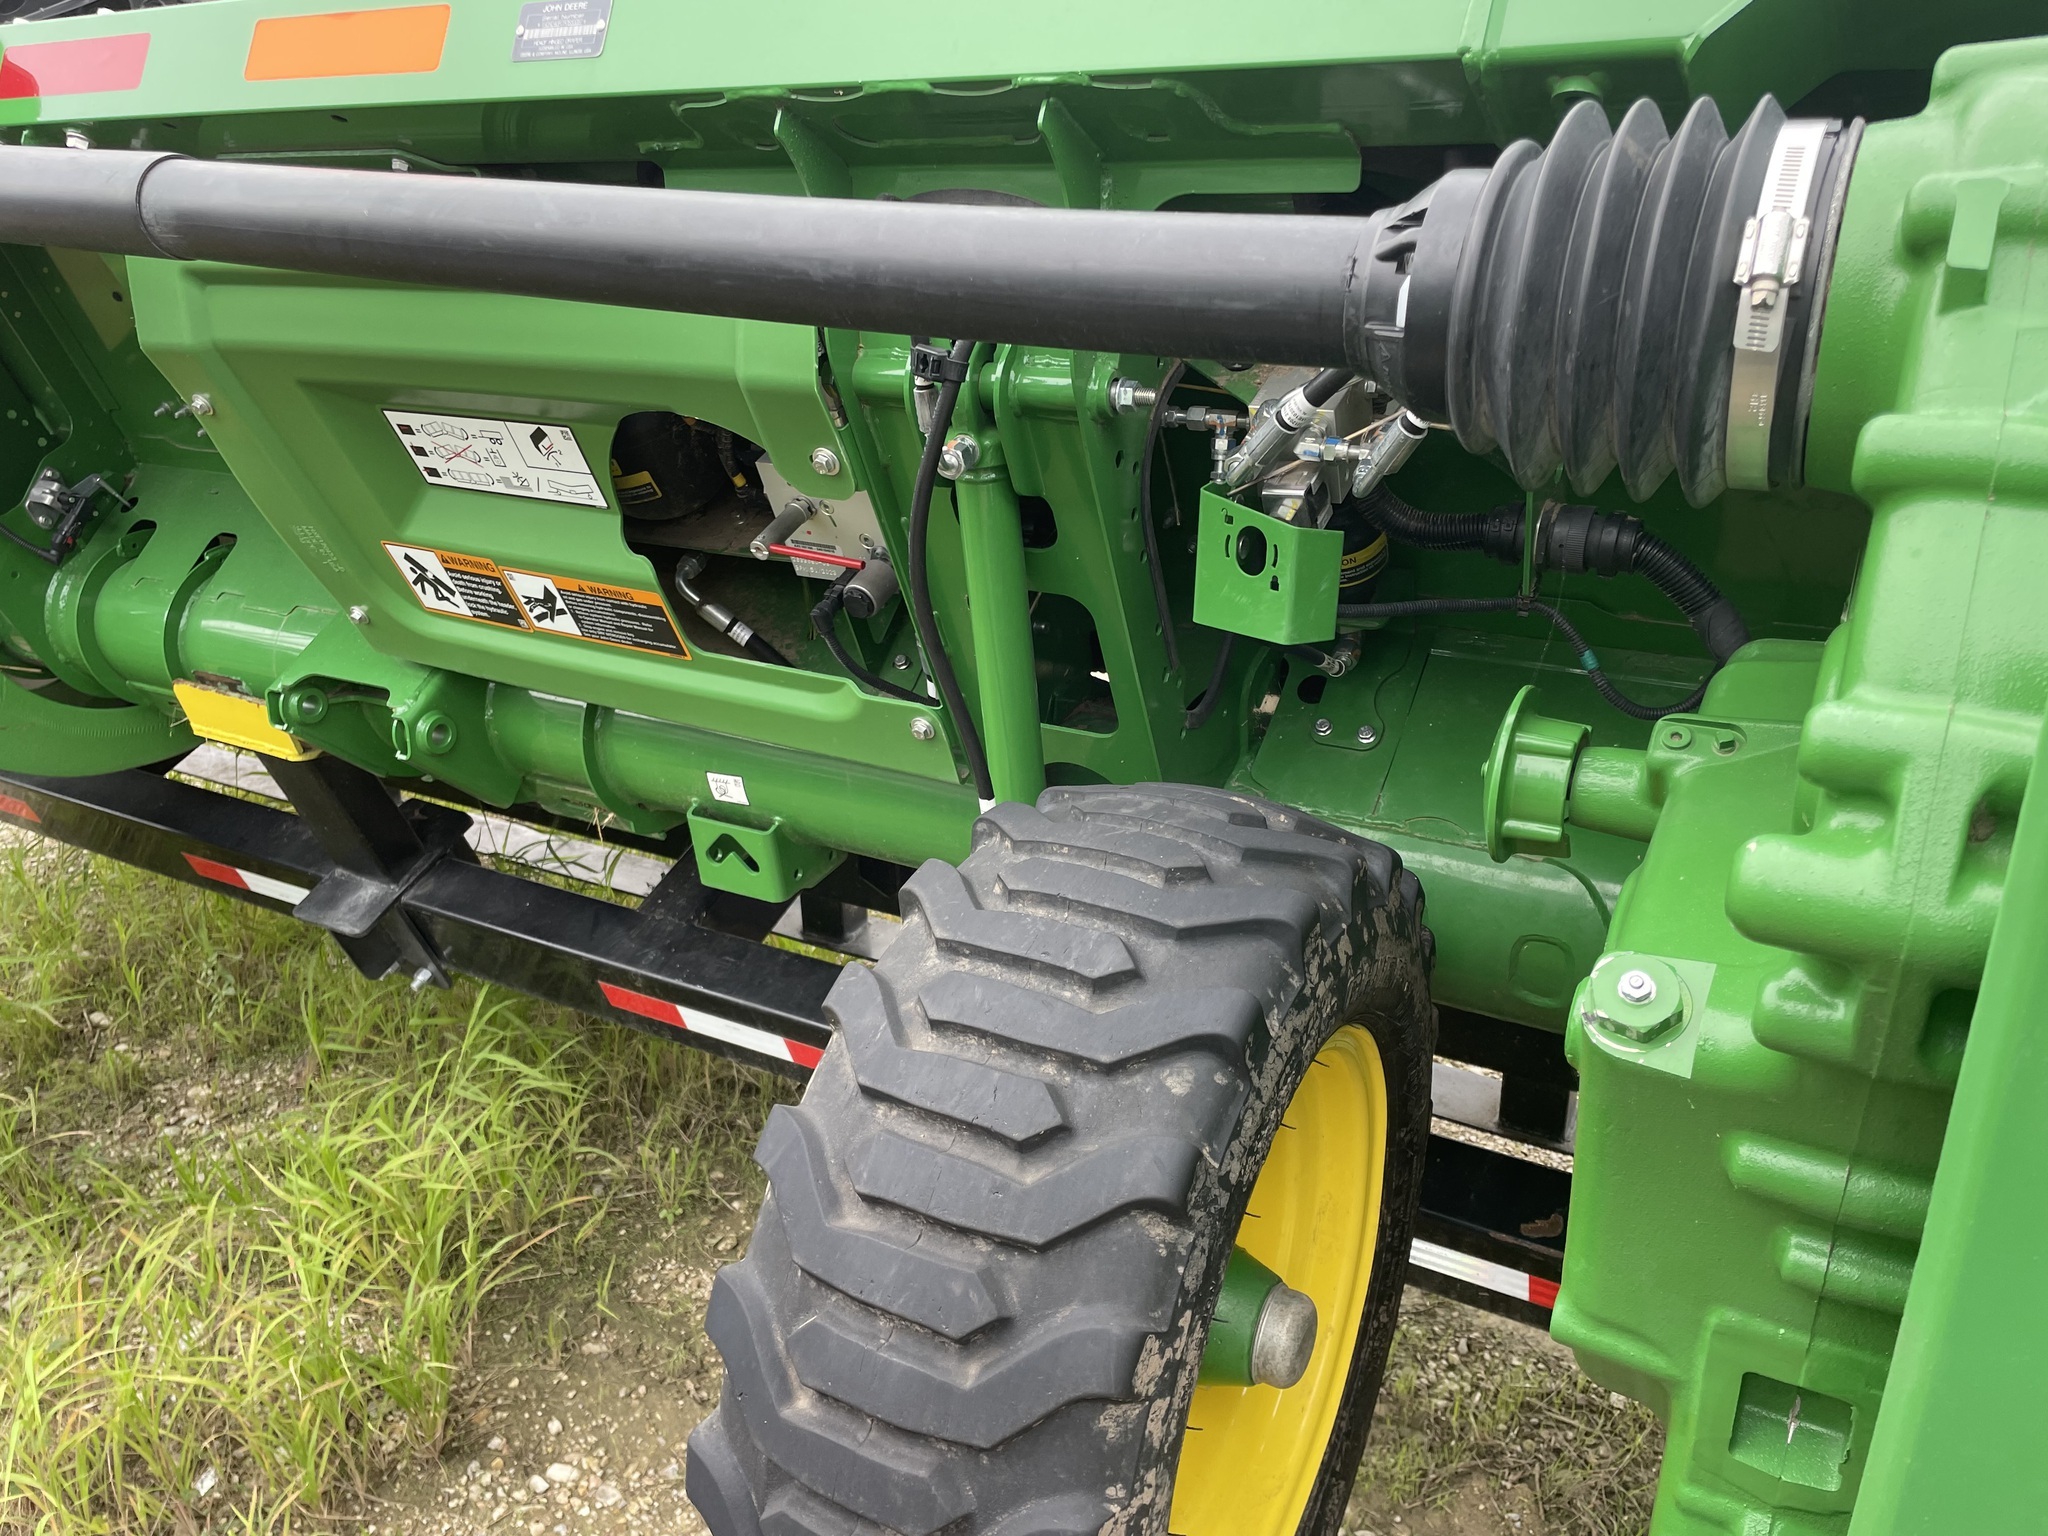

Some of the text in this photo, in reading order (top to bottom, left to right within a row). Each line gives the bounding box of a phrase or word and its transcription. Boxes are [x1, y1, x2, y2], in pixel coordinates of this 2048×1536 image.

[543, 2, 588, 13] JOHN DEERE
[448, 556, 496, 572] WARNING
[1342, 557, 1356, 566] ON
[586, 585, 634, 600] WARNING
